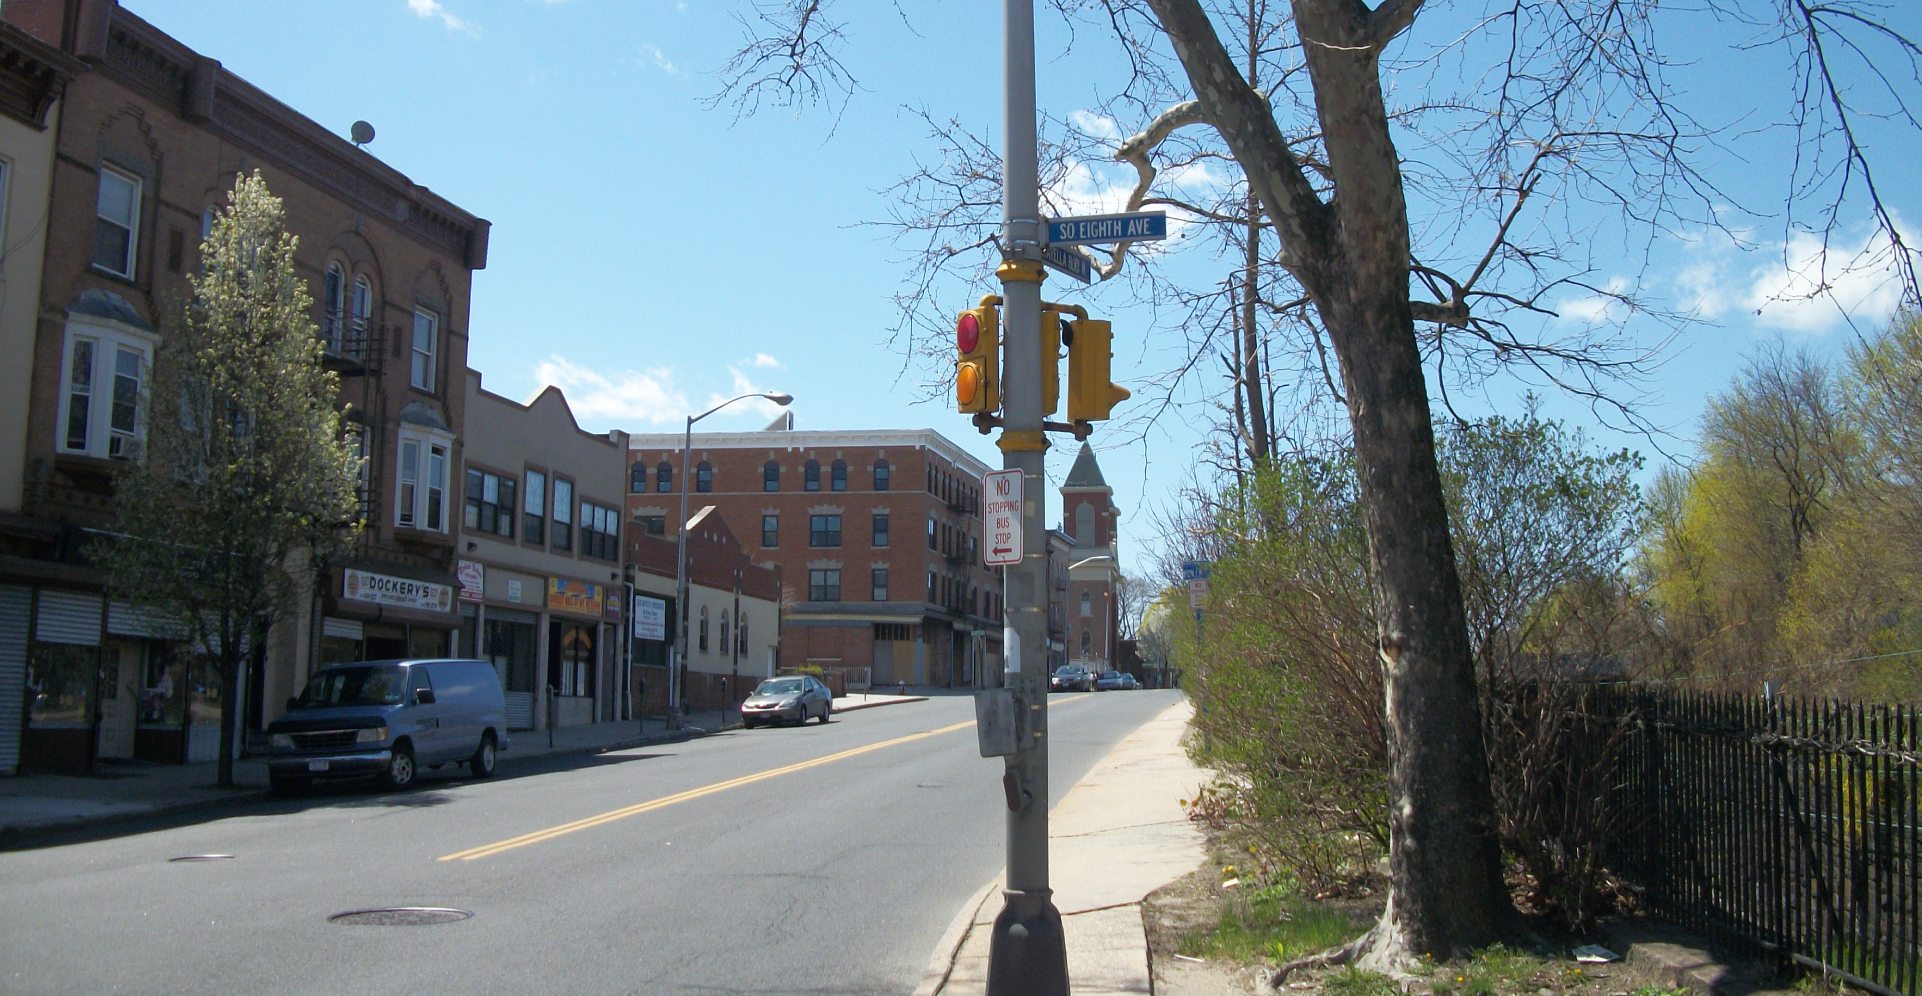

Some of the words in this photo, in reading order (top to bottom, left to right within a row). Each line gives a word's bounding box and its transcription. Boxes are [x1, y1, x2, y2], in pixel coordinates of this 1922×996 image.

[1060, 222, 1075, 240] SO
[1080, 220, 1122, 239] EIGHTH
[1127, 218, 1152, 236] AVE
[996, 479, 1010, 496] NO
[988, 500, 1019, 514] STOPPING
[996, 516, 1010, 529] BUS
[995, 532, 1012, 545] STOP
[369, 575, 430, 598] DOCKERY'S
